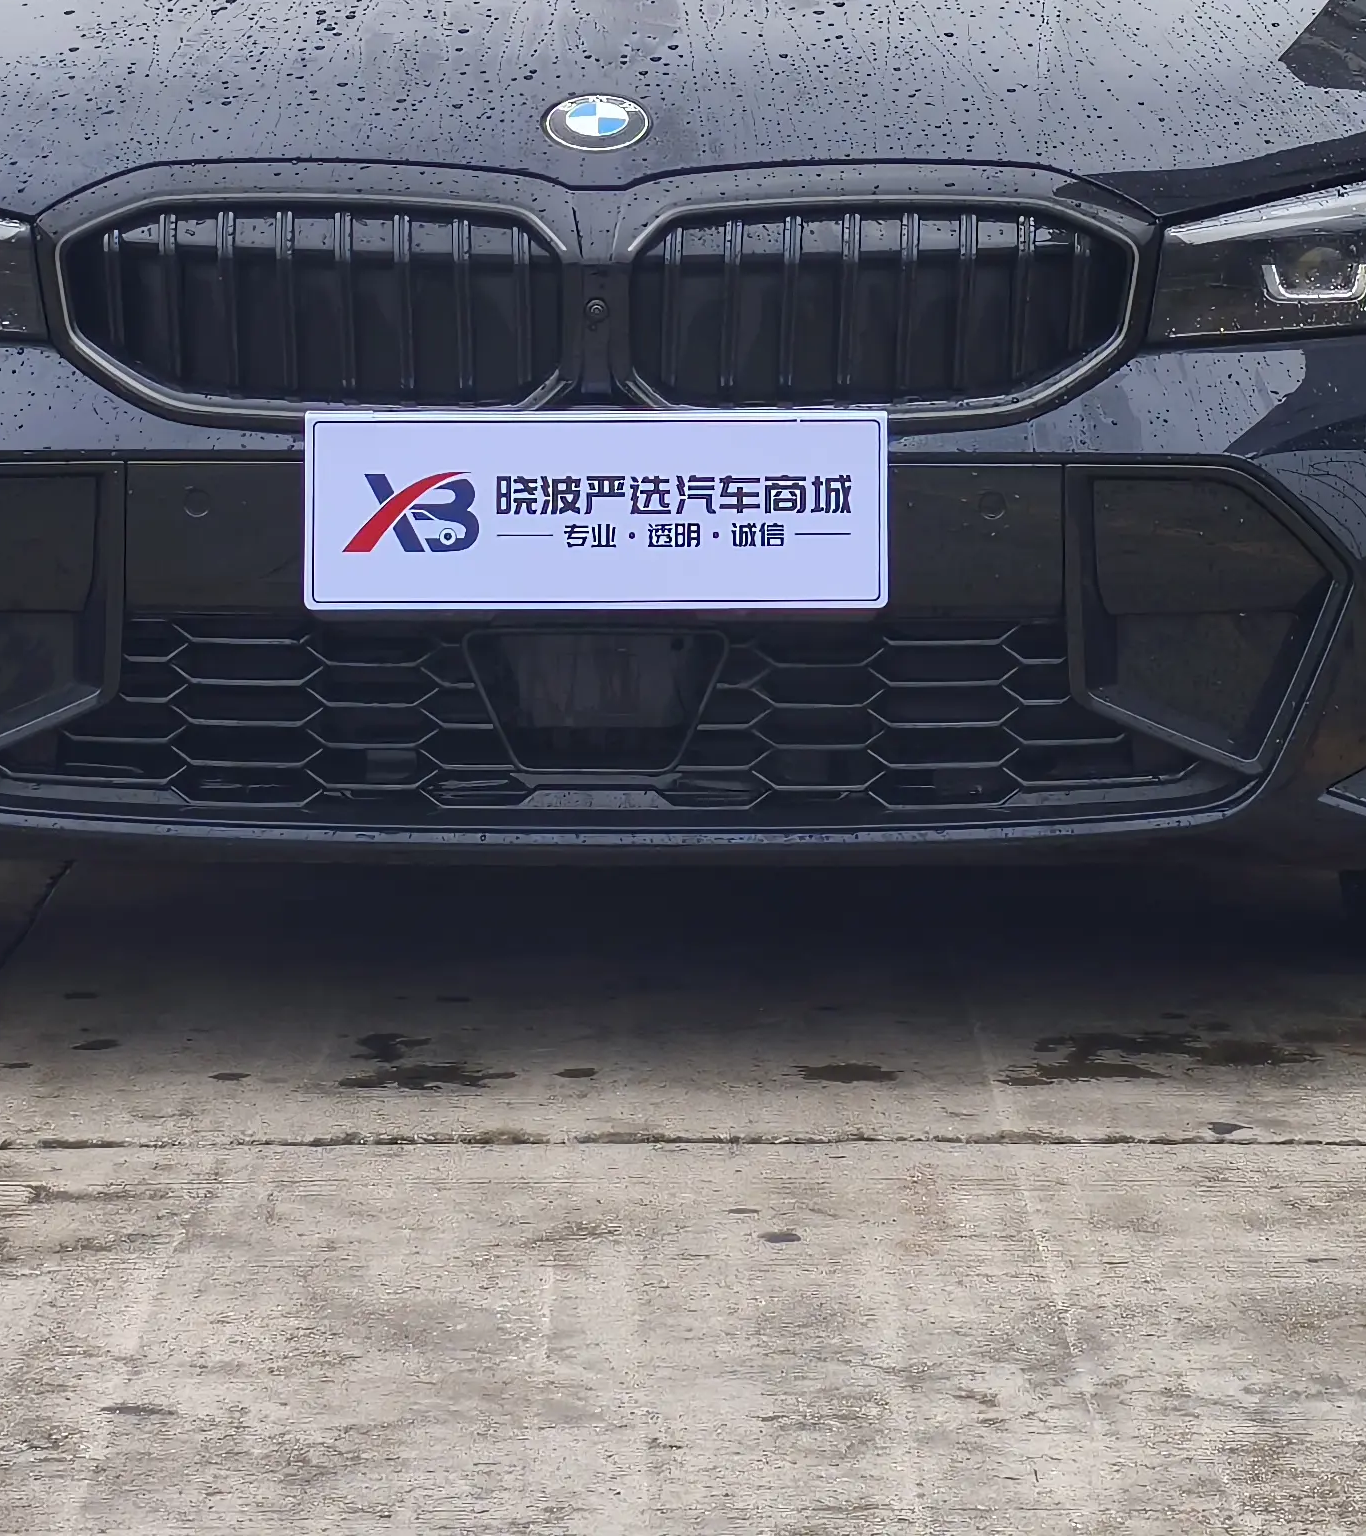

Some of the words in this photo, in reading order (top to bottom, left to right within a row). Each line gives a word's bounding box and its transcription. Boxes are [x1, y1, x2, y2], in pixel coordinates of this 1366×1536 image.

[496, 474, 852, 515] 晓波严选汽车商城
